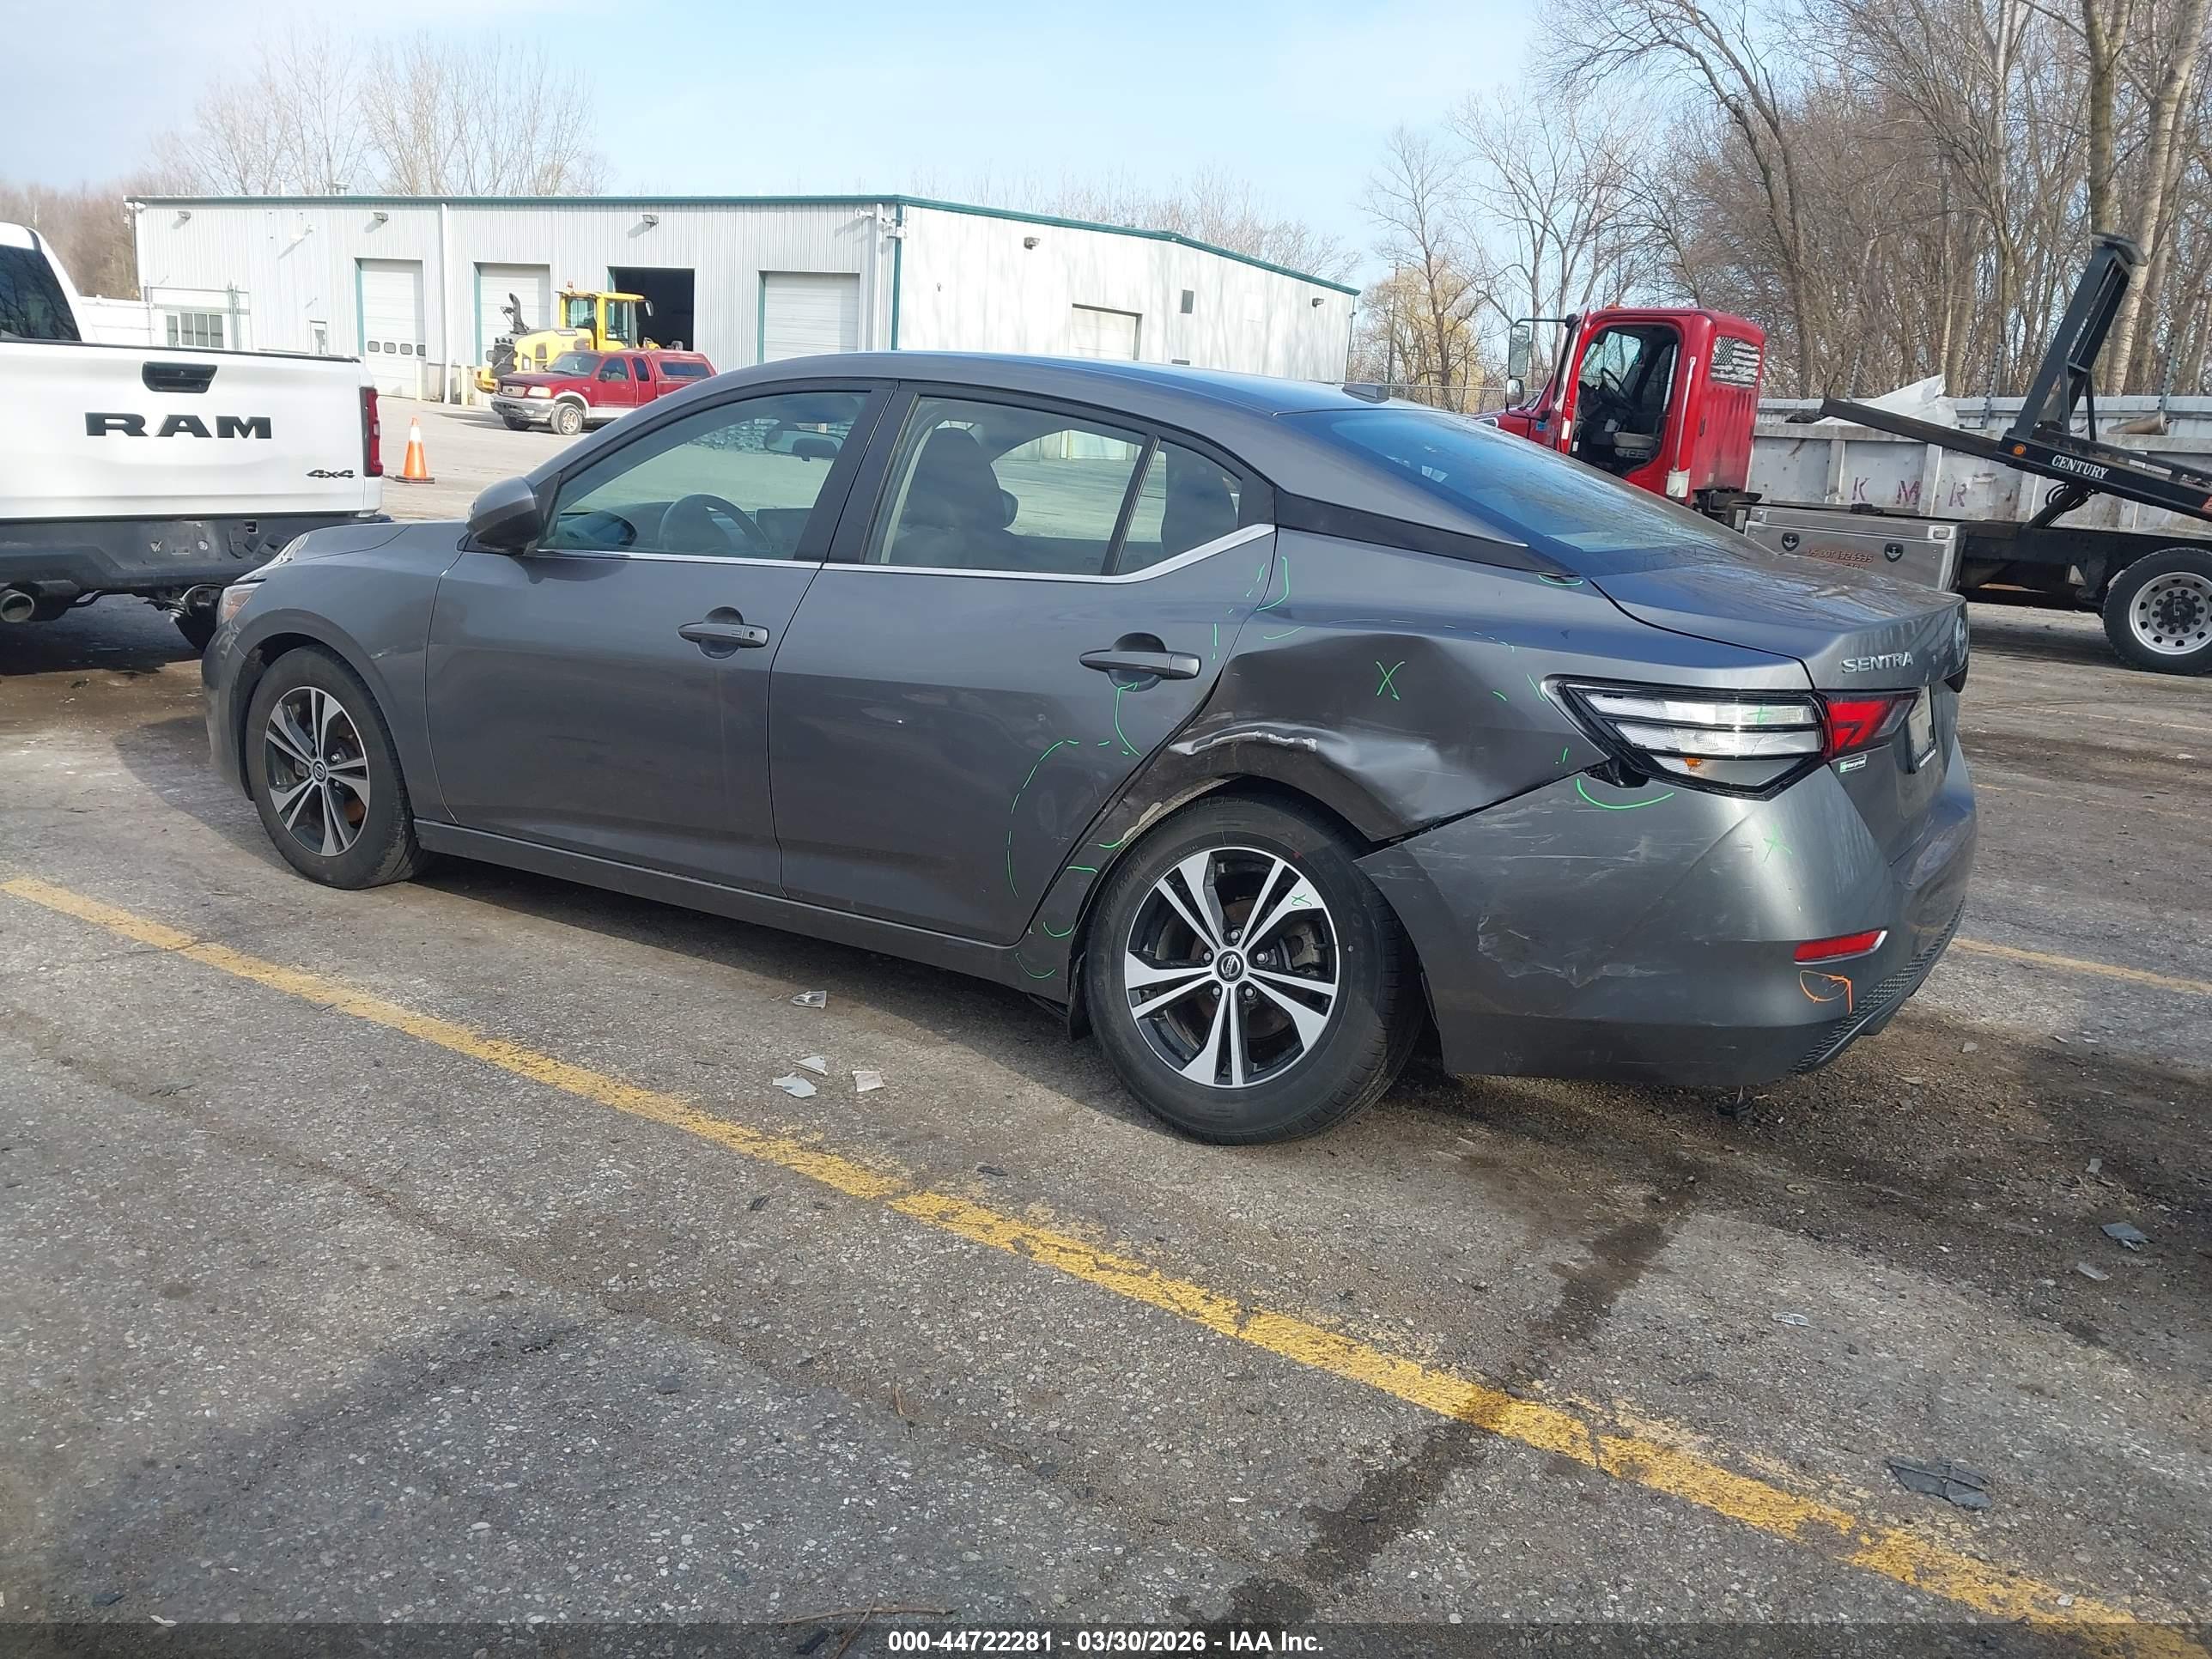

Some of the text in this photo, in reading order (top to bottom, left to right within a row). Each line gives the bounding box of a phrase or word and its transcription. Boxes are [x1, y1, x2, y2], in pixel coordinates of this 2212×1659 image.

[85, 412, 272, 439] RAM
[305, 469, 356, 479] 4x4
[2051, 454, 2109, 479] CENTURY
[1840, 651, 1914, 674] SENTRA
